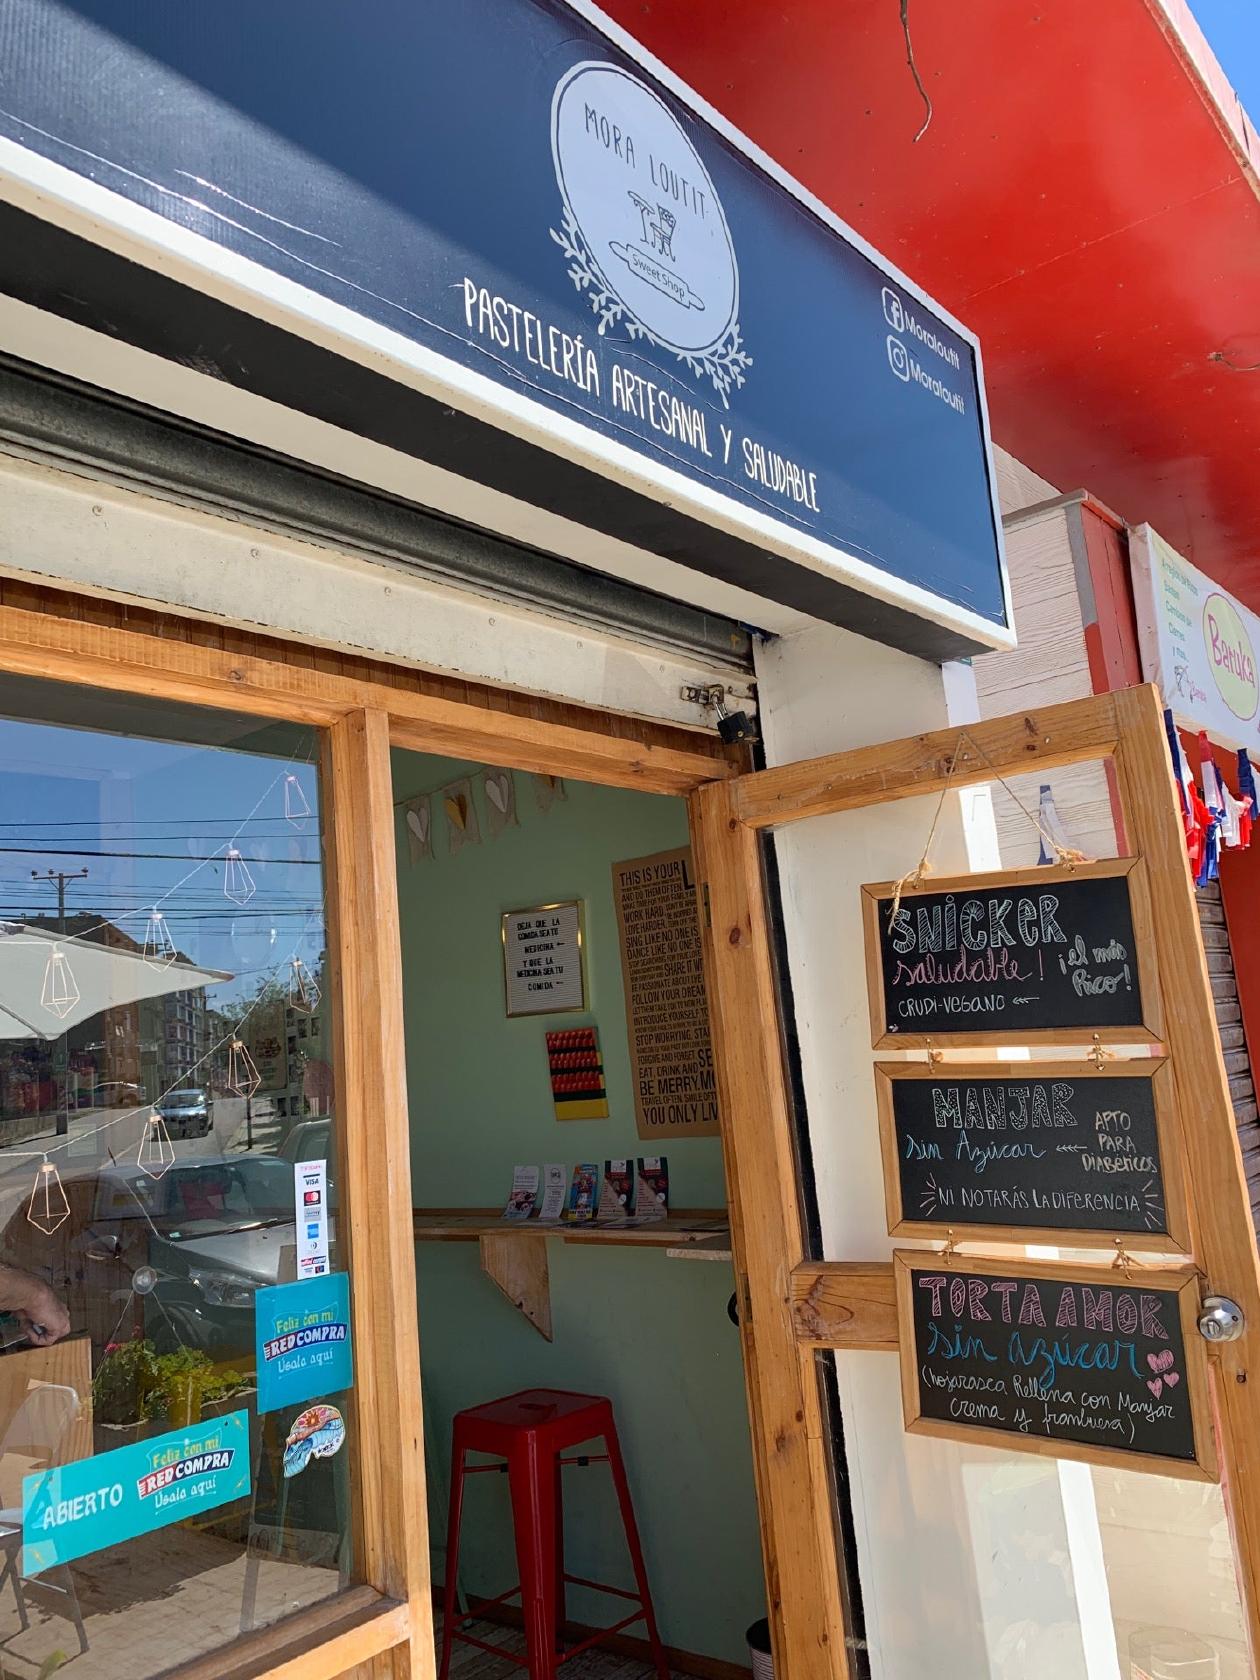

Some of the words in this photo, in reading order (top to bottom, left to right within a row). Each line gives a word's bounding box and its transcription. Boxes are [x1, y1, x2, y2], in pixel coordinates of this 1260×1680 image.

[585, 102, 635, 168] MORA
[650, 154, 705, 219] LOUTIT
[632, 254, 662, 282] Sweet
[661, 274, 685, 300] Shop
[464, 278, 600, 396] PASTELERÍA
[612, 366, 712, 458] ARTESANAL
[720, 425, 732, 464] Y
[743, 437, 820, 513] SALUDABLE
[619, 870, 641, 887] THIS
[642, 867, 652, 883] IS
[653, 861, 680, 880] YOUR
[552, 918, 560, 926] LA
[624, 910, 643, 924] WORK
[625, 934, 642, 949] SING
[645, 931, 660, 945] LIKE
[662, 929, 673, 942] NO
[675, 927, 690, 940] ONE
[691, 926, 698, 938] IS
[627, 946, 650, 960] DANCE
[651, 943, 666, 957] LIKE
[667, 941, 678, 953] NO
[679, 938, 692, 951] ONE
[664, 962, 686, 977] SHARE
[632, 990, 659, 1006] FOLLOW
[661, 988, 680, 1001] YOUR
[633, 1011, 668, 1026] INTRODUCE
[669, 1008, 698, 1021] YOURSELF
[636, 1034, 653, 1046] STOP
[698, 1047, 712, 1068] SE
[656, 1064, 680, 1078] DRINK
[681, 1062, 698, 1074] AND
[640, 1080, 654, 1096] BE
[658, 1074, 700, 1095] MERRY.
[643, 1106, 665, 1125] YOU
[667, 1103, 697, 1124] ONLY
[702, 1102, 718, 1121] LIV
[932, 1082, 1078, 1130] MANJAR
[1095, 1110, 1131, 1132] APTO
[1098, 1133, 1137, 1154] PARA
[305, 1178, 319, 1186] VISA
[961, 1185, 1030, 1209] NOTARÁS
[918, 1276, 1047, 1327] TORTA
[1056, 1286, 1169, 1340] AMOR
[276, 1318, 300, 1333] Feliz
[304, 1313, 319, 1326] con
[321, 1309, 334, 1323] mi
[278, 1354, 307, 1373] Úsala
[310, 1348, 334, 1367] aquí
[1013, 1405, 1033, 1432] y
[1081, 1393, 1112, 1412] con
[1118, 1391, 1176, 1423] Manjar
[153, 1451, 180, 1468] Feliz
[183, 1442, 201, 1457] con
[200, 1436, 220, 1452] mi
[154, 1490, 187, 1509] Úsala
[190, 1475, 217, 1498] aquí
[43, 1483, 123, 1531] ABIERTO
